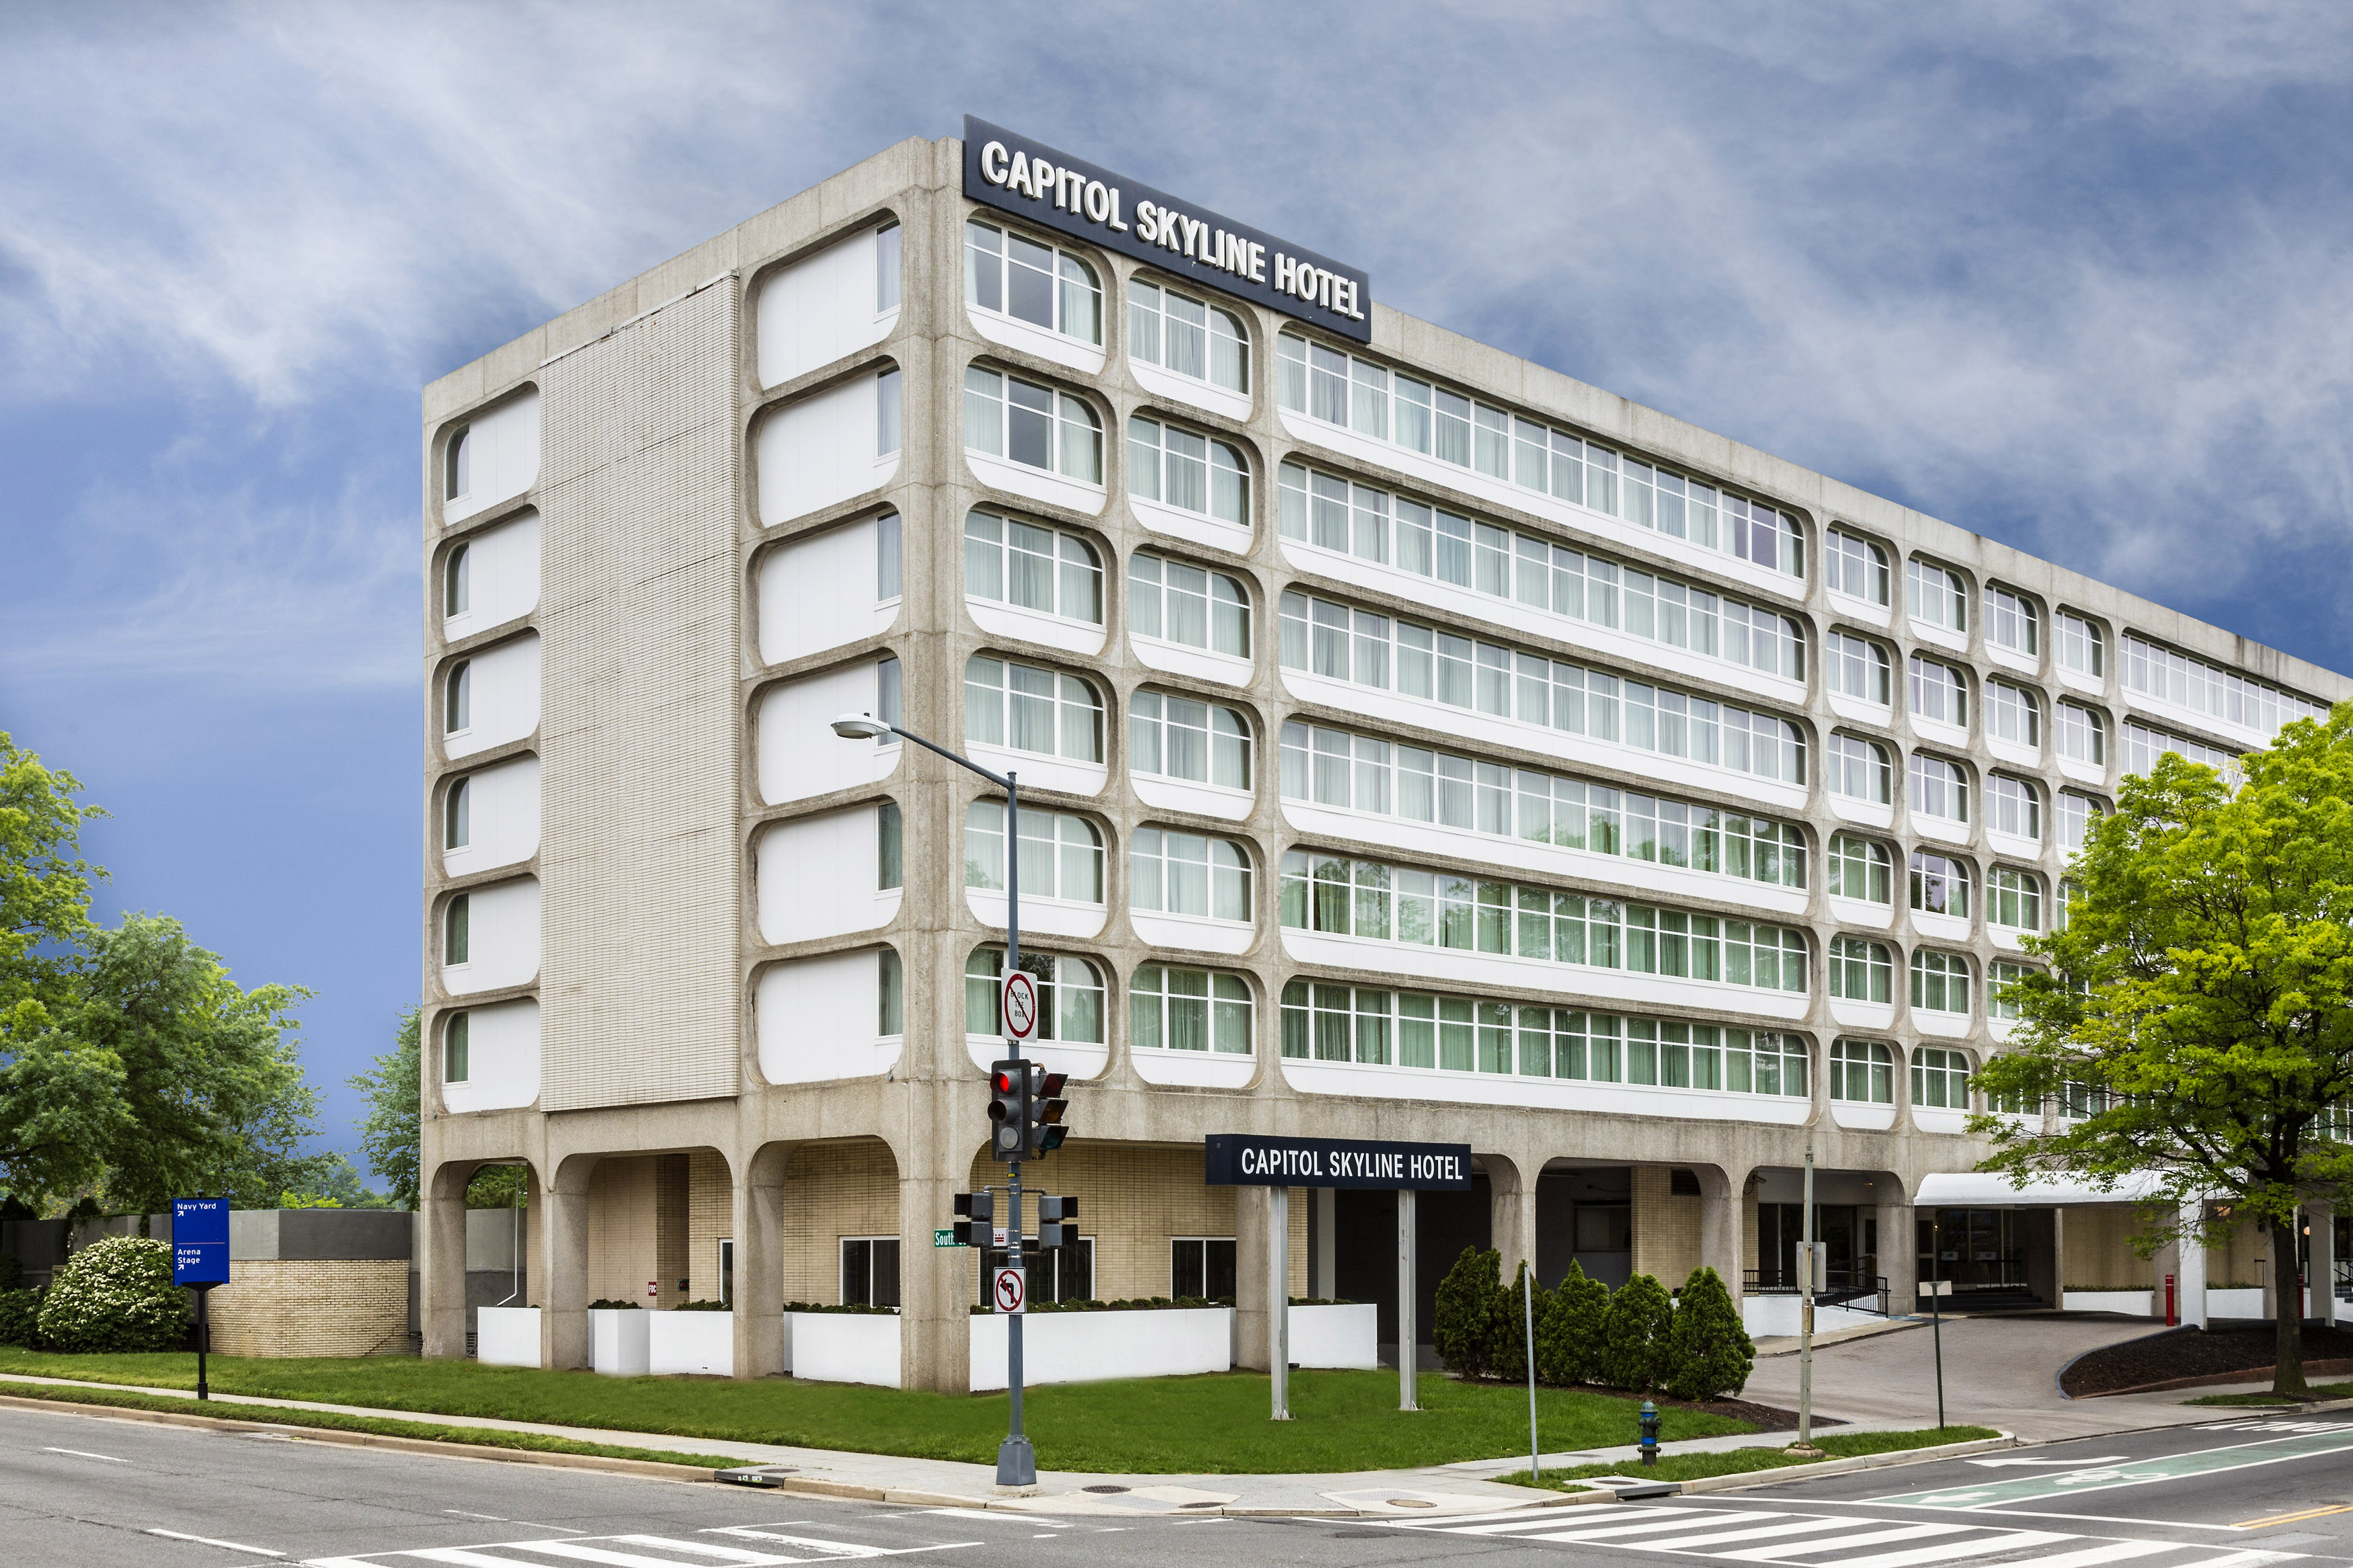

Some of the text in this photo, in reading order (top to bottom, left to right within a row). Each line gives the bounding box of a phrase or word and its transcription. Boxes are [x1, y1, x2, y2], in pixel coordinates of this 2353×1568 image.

[981, 140, 1365, 321] CAPITOL SKYLINE HOTEL
[1242, 1148, 1463, 1180] CAPITOL SKYLINE HOTEL
[177, 1257, 200, 1265] Stage
